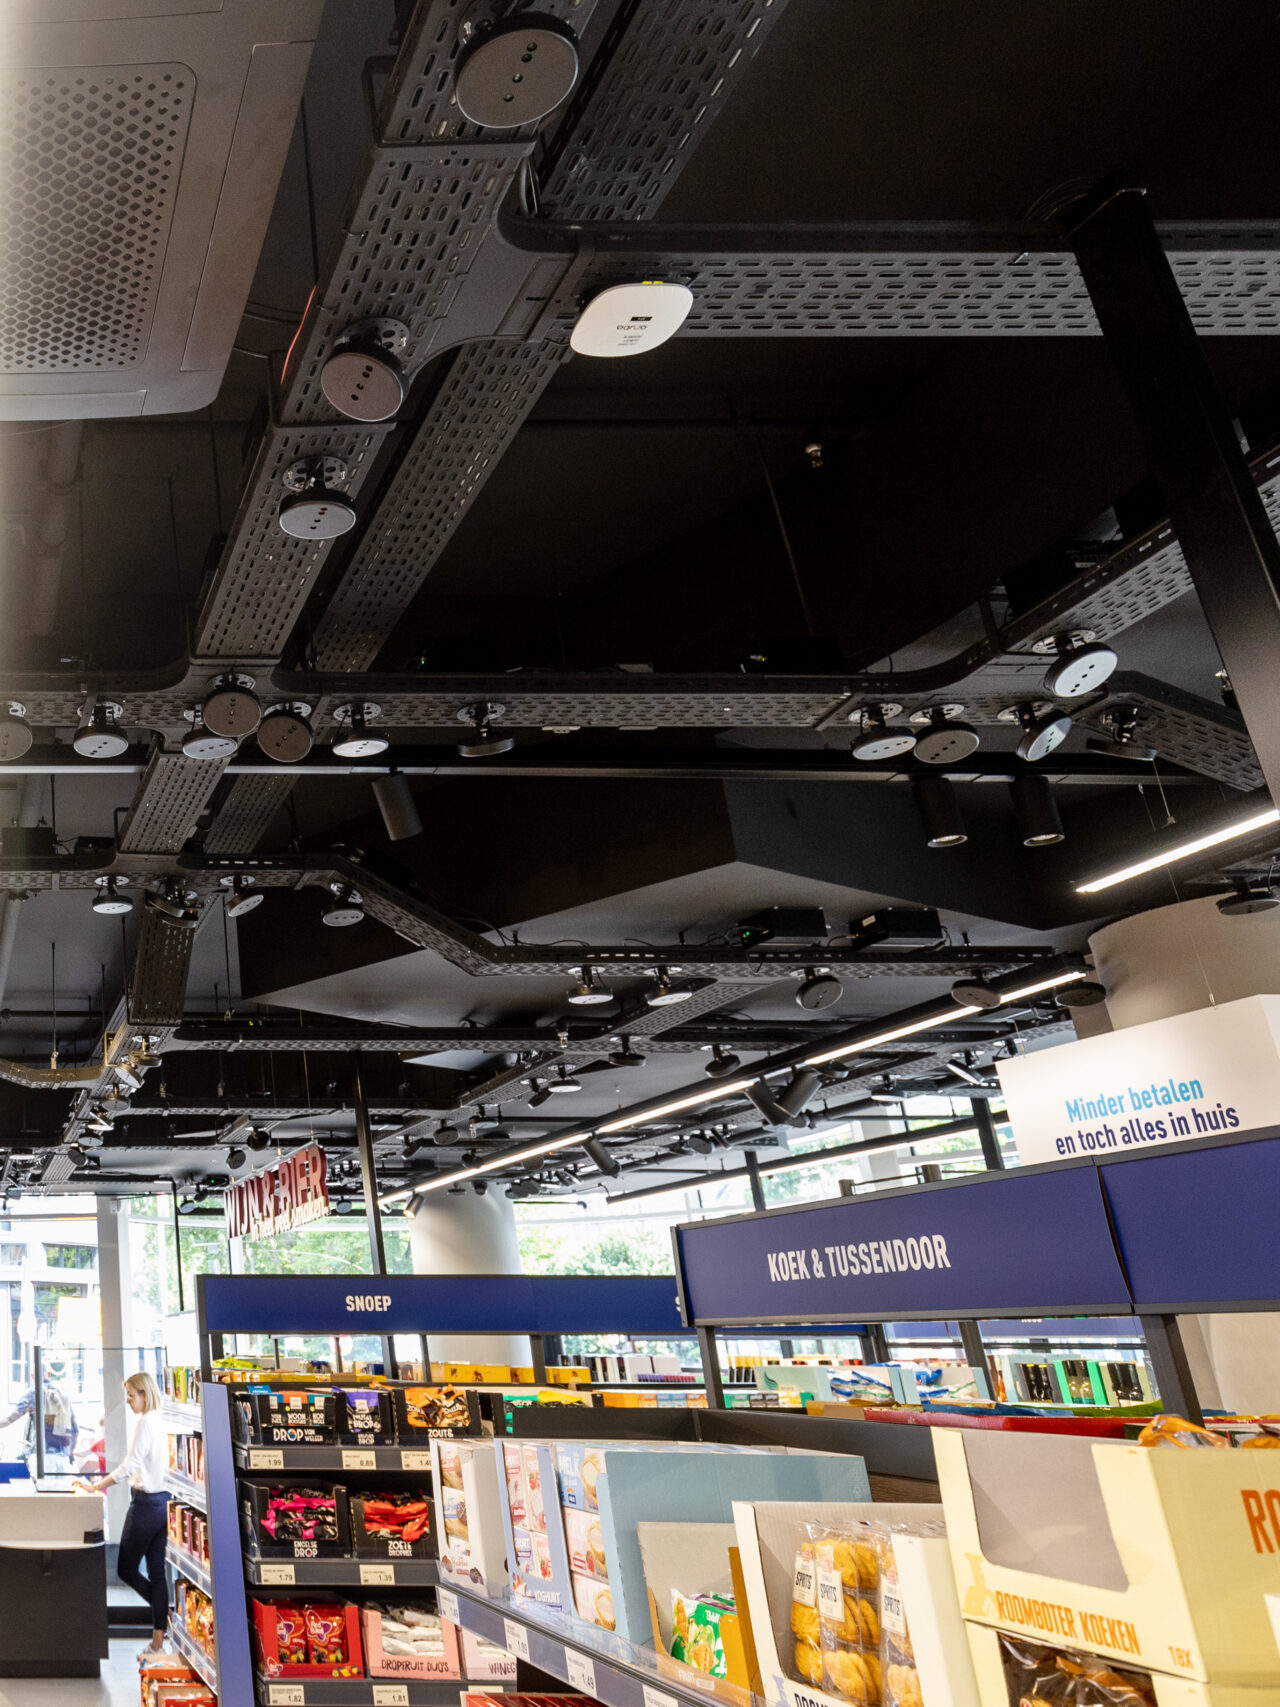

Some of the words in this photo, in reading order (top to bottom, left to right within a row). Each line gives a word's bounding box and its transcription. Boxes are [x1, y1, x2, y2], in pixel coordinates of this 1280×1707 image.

[1066, 1093, 1125, 1123] Minder
[1128, 1078, 1205, 1111] betalen
[1055, 1136, 1077, 1155] en
[1078, 1124, 1118, 1151] toch
[1120, 1118, 1168, 1144] alles
[1168, 1112, 1191, 1137] in
[1191, 1103, 1240, 1133] huis
[223, 1176, 261, 1239] WIJN
[278, 1146, 329, 1214] BIER
[767, 1249, 811, 1282] KOEK
[811, 1248, 826, 1279] &
[825, 1234, 951, 1277] TUSSENDOOR
[345, 1295, 391, 1313] SNOEP
[273, 1428, 304, 1441] DROP
[359, 1459, 374, 1467] 0.89
[294, 1548, 318, 1558] DROP
[279, 1574, 293, 1582] 1.79
[378, 1574, 393, 1582] 1.39
[795, 1571, 812, 1590] SPRITS
[534, 1590, 561, 1604] YOGHURT
[820, 1583, 837, 1602] SPRITS
[884, 1594, 901, 1616] SPRITS
[995, 1590, 1078, 1639] ROOMBOTER
[1079, 1611, 1141, 1656] KOEKEN
[381, 1659, 423, 1671] DROPFRUIT
[427, 1662, 449, 1672] DUO'S
[1168, 1646, 1194, 1670] 18X
[582, 1671, 595, 1691] 1.49
